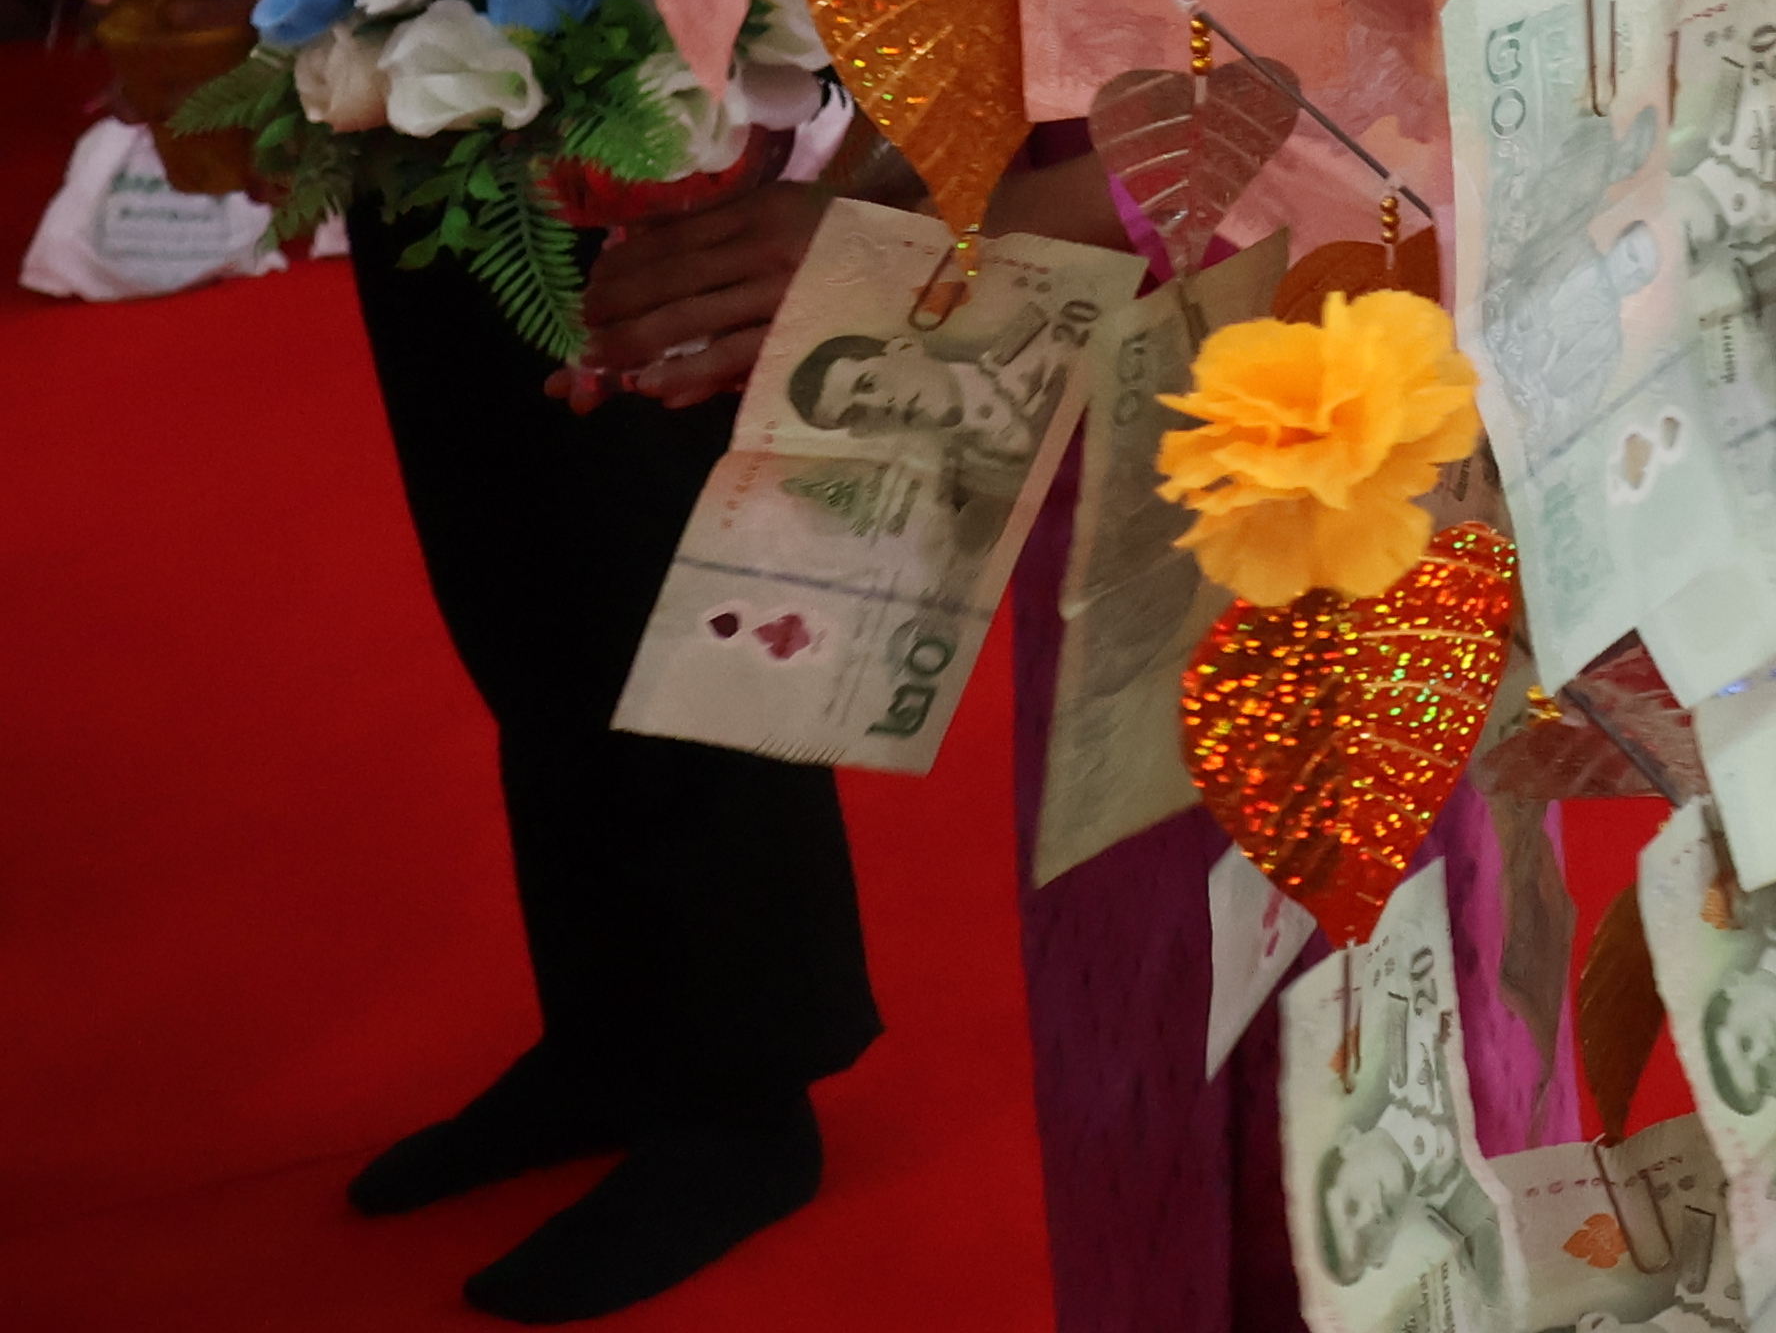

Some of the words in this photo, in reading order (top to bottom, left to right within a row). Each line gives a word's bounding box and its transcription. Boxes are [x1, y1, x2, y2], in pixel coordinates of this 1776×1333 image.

[1053, 299, 1102, 350] 20
[864, 635, 959, 740] ๒๐
[1410, 945, 1439, 1016] 20
